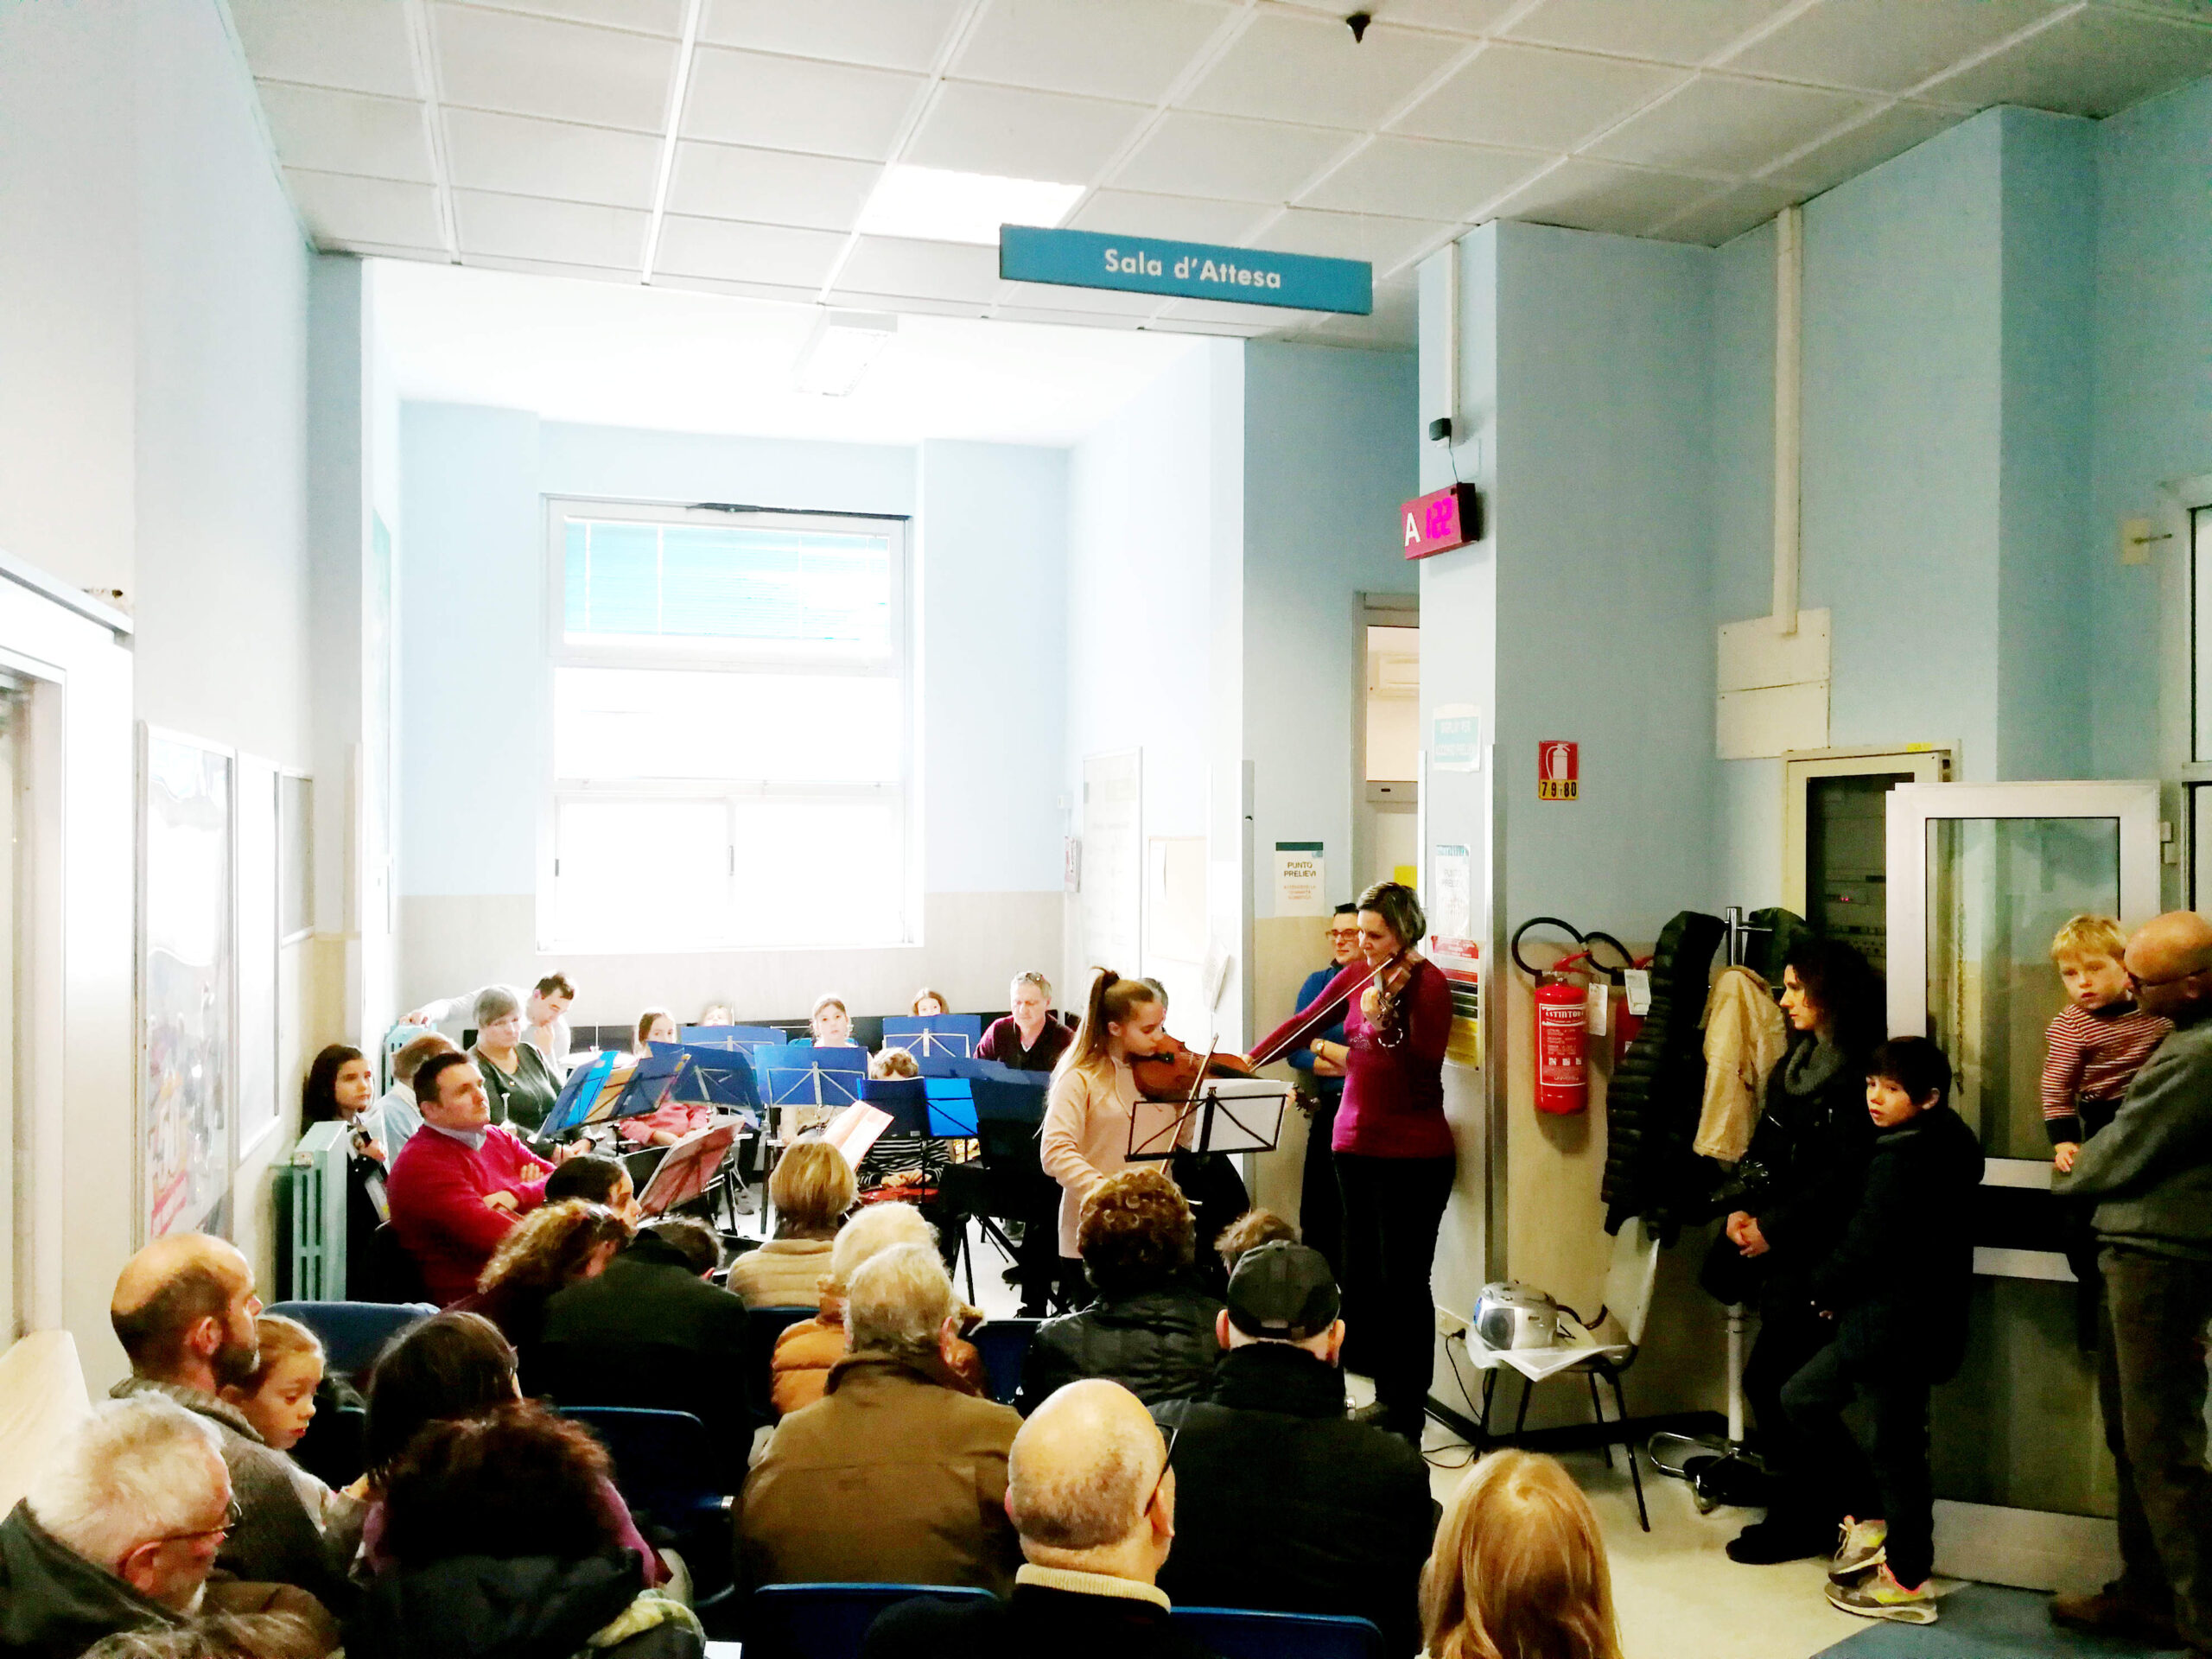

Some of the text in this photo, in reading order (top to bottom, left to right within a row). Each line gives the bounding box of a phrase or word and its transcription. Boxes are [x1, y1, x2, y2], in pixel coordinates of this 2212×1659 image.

[1104, 248, 1281, 289] Sala d'Attesa
[1404, 512, 1421, 547] A
[1283, 869, 1317, 878] PRELIEVI
[1287, 861, 1313, 869] PUNTO
